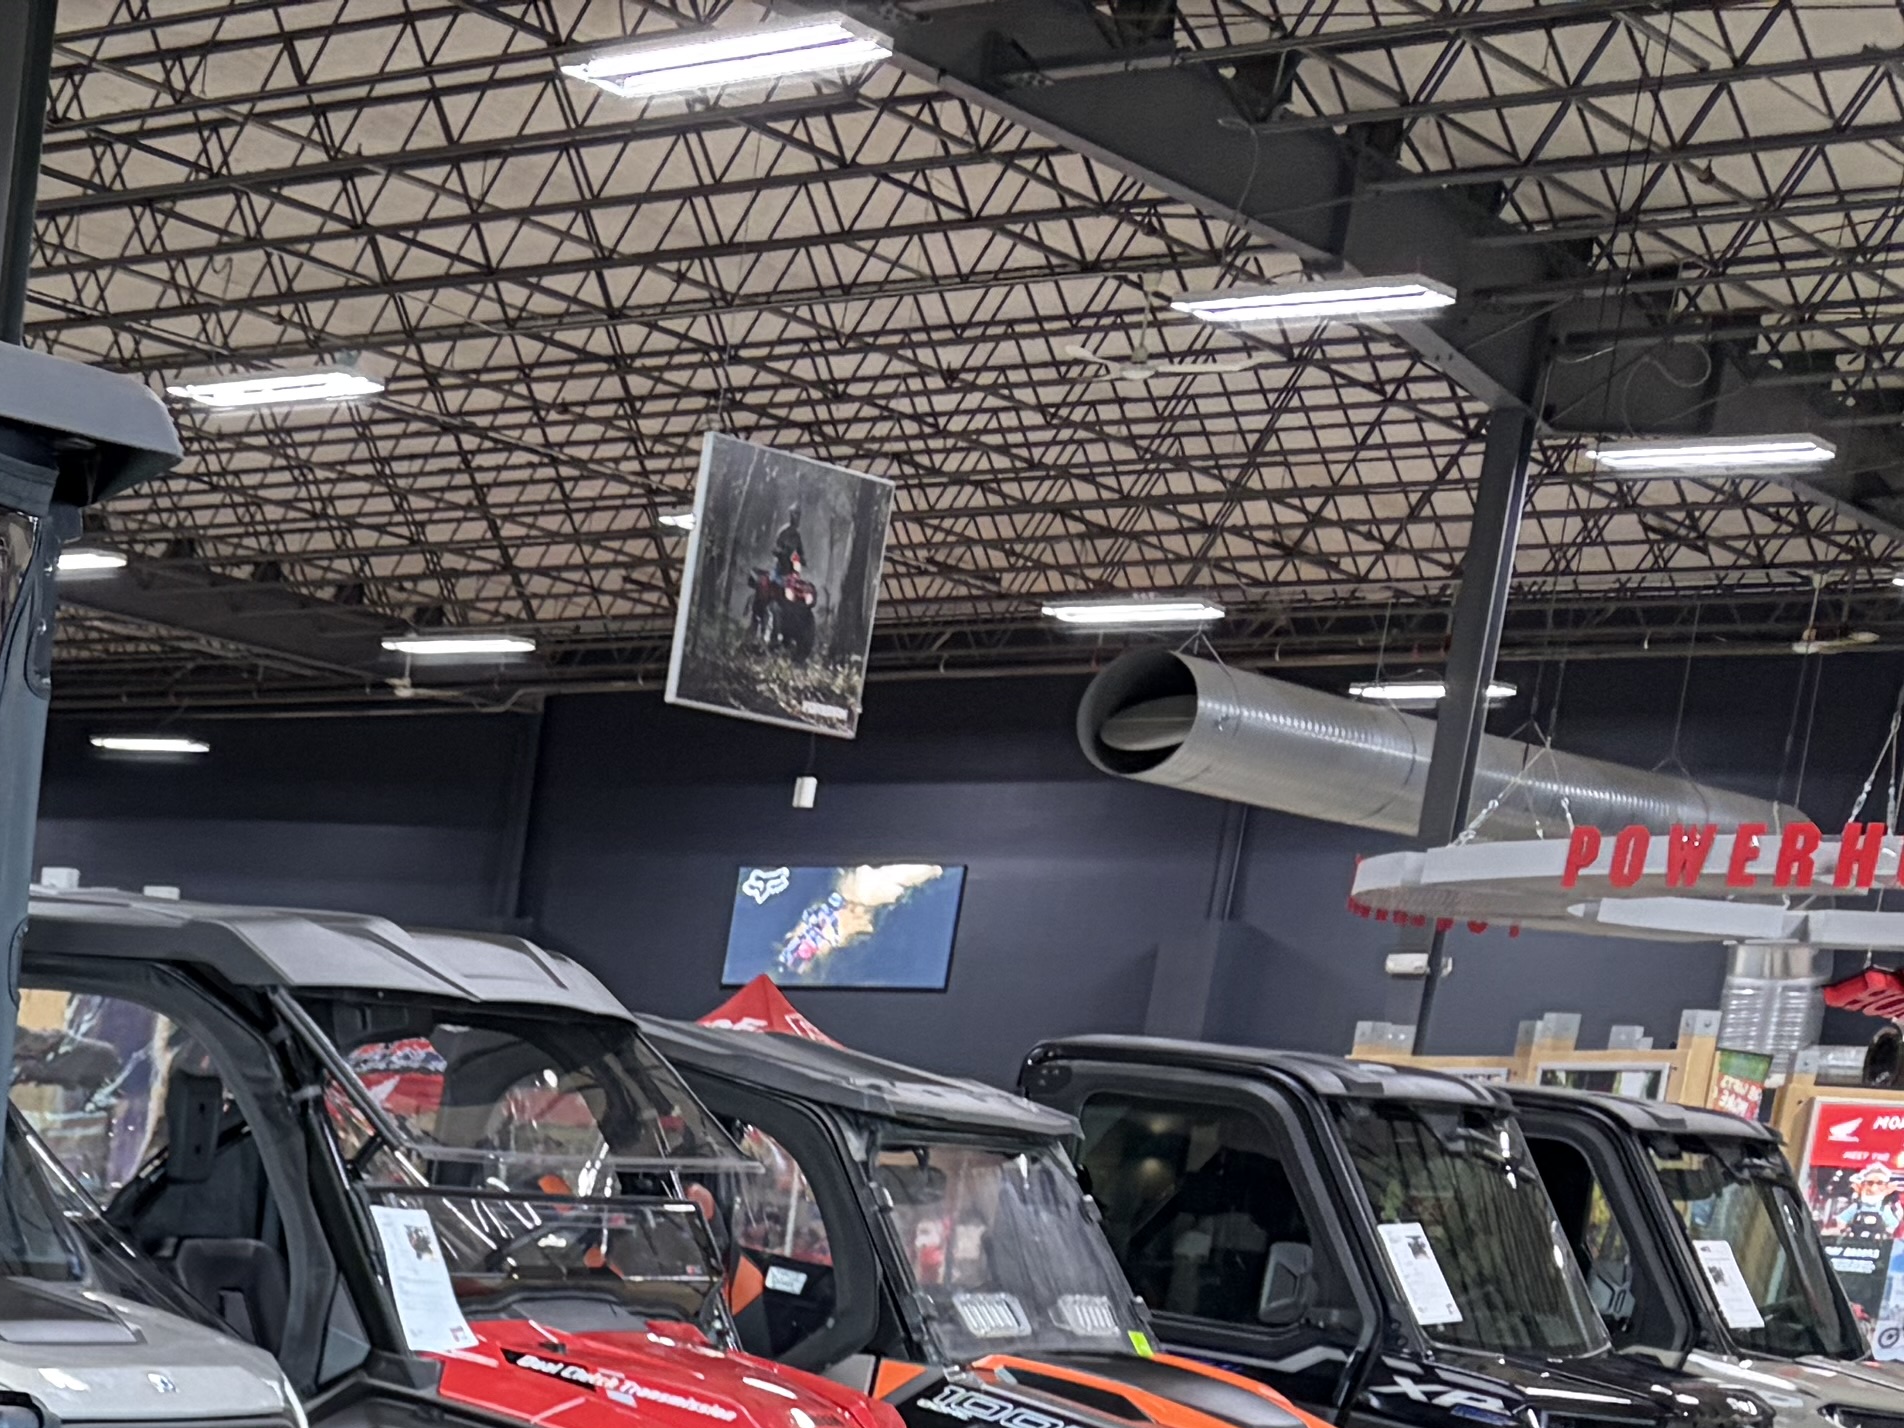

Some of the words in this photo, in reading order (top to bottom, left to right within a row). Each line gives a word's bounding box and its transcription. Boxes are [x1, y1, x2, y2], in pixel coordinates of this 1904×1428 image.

[1561, 822, 1904, 888] POWERH
[1872, 1115, 1904, 1130] MO
[1368, 1375, 1512, 1416] XP
